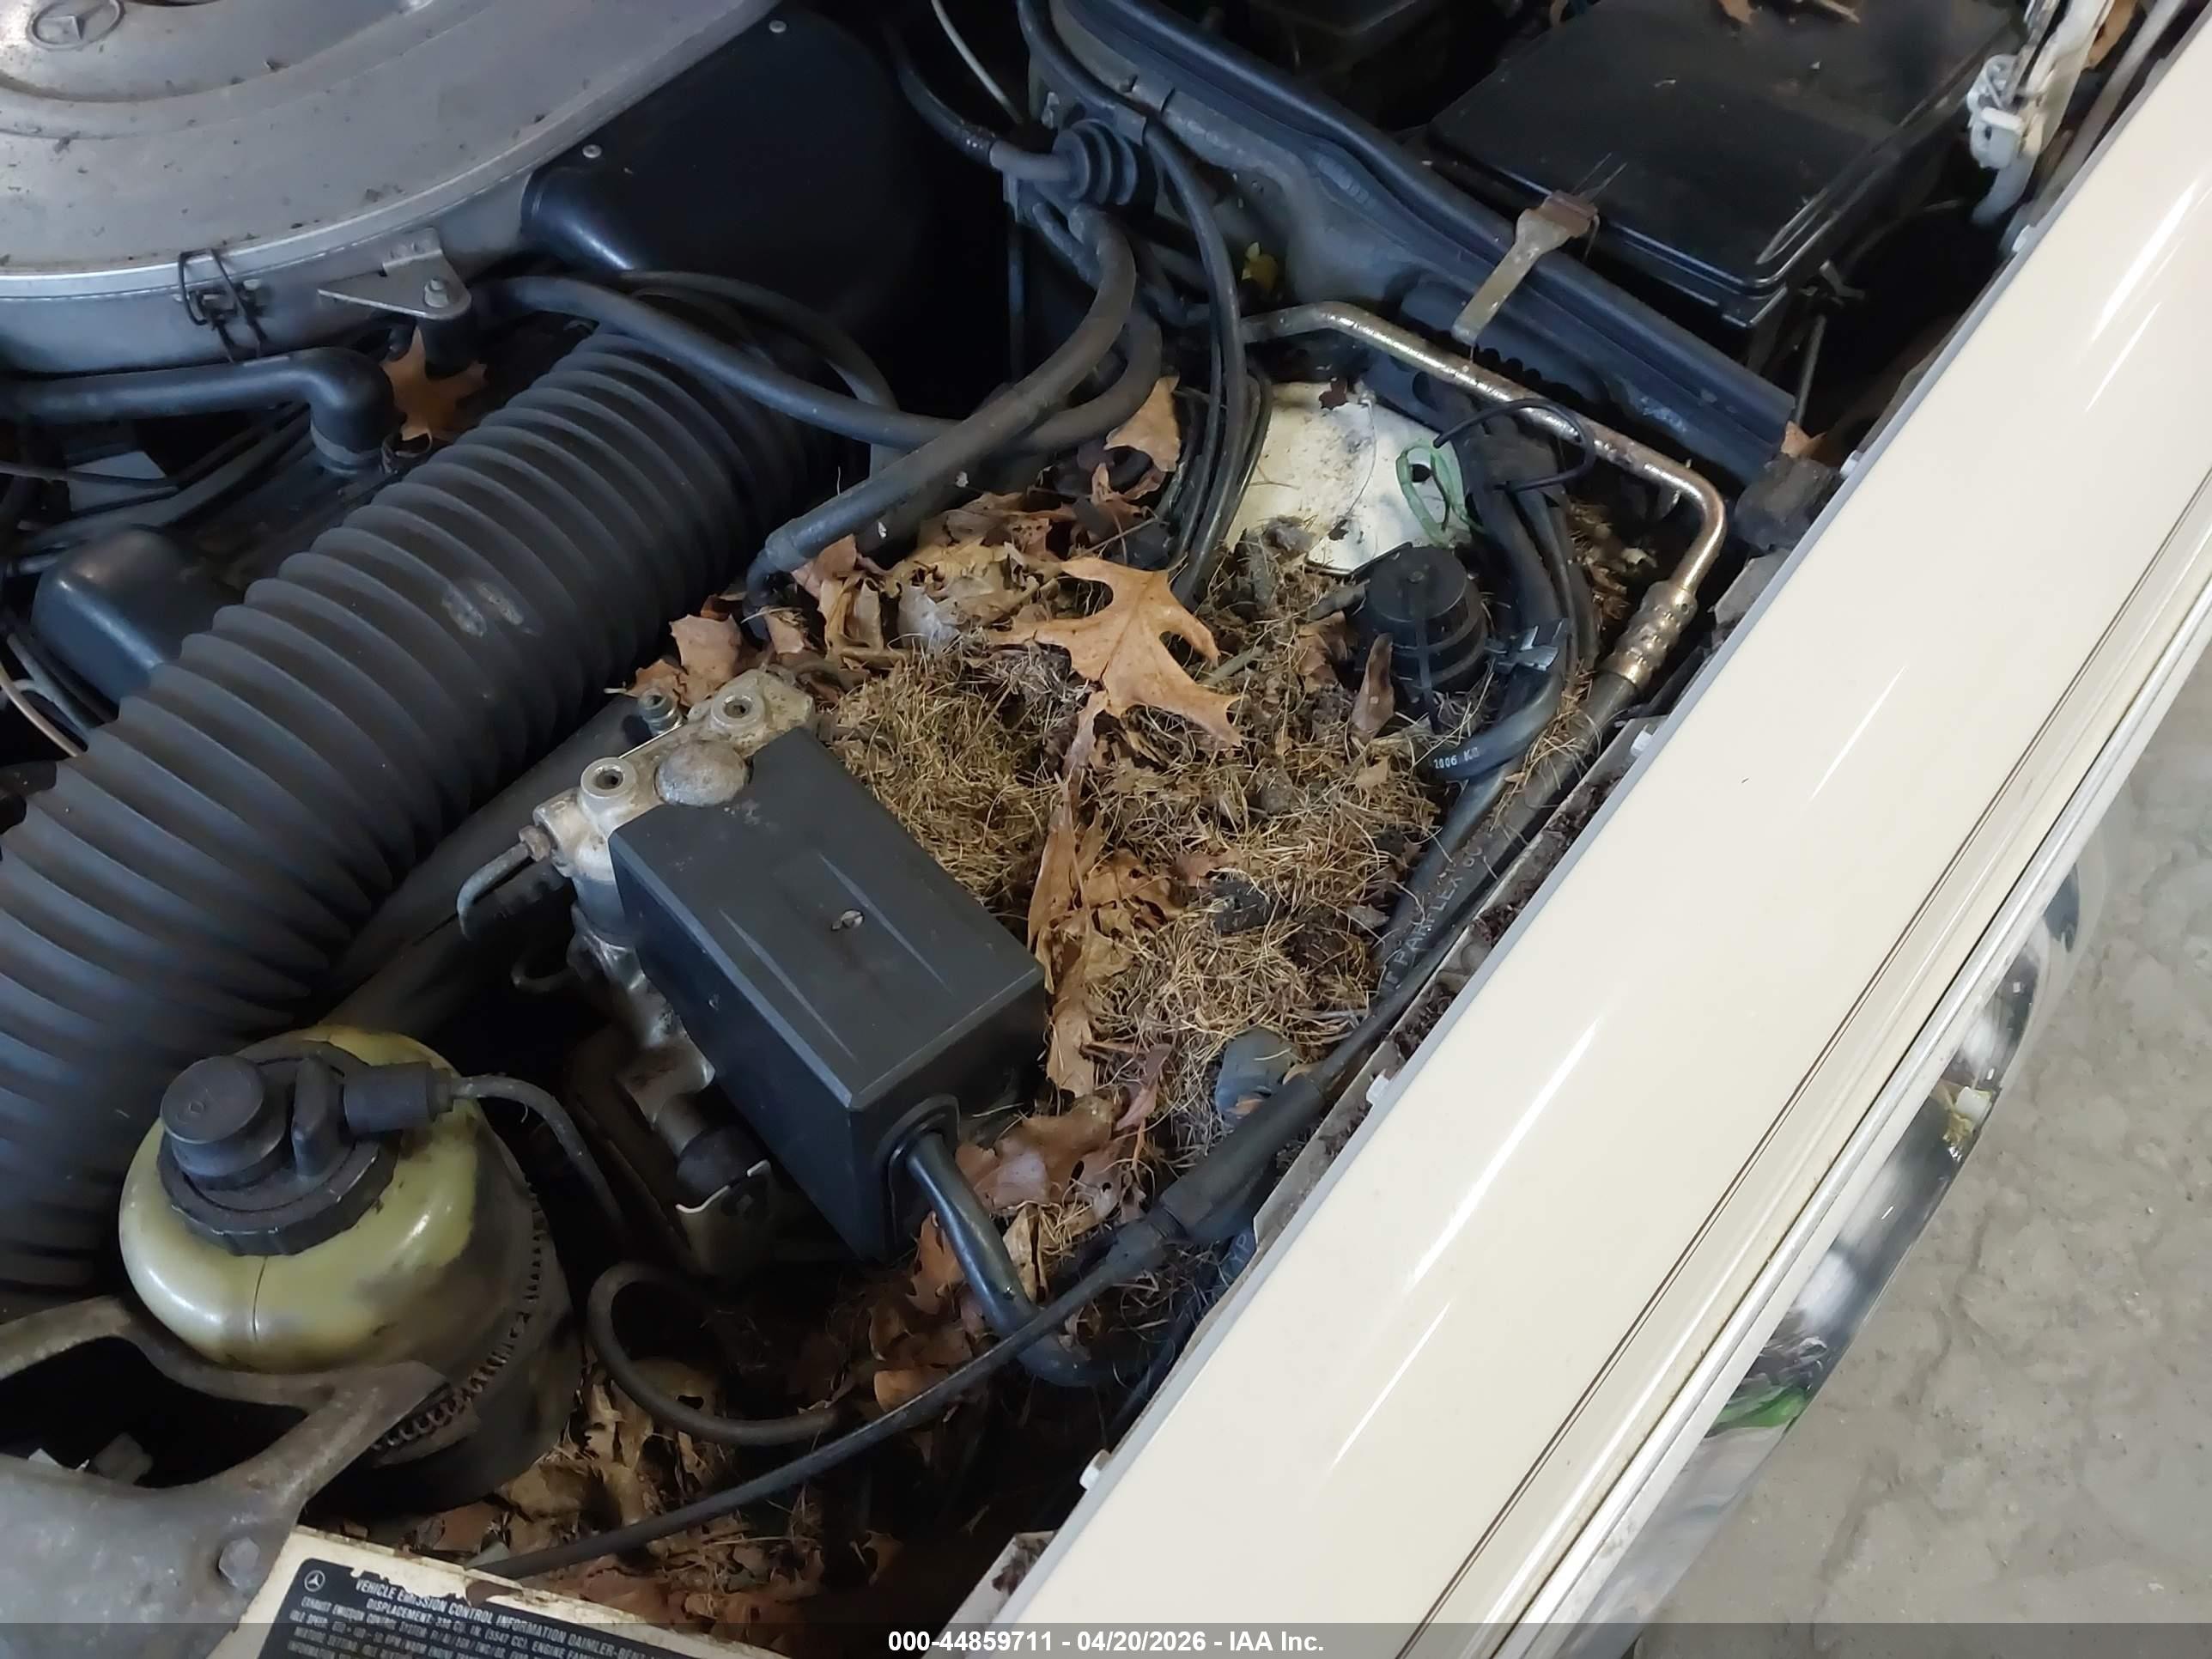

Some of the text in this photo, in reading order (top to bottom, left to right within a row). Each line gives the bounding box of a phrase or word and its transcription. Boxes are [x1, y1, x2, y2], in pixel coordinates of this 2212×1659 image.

[356, 1579, 398, 1601] VEHICLE
[398, 1589, 448, 1613] EMISSION
[448, 1602, 493, 1625] CONTROL
[495, 1614, 567, 1644] INFORMATION
[532, 1641, 566, 1659] ENGINE
